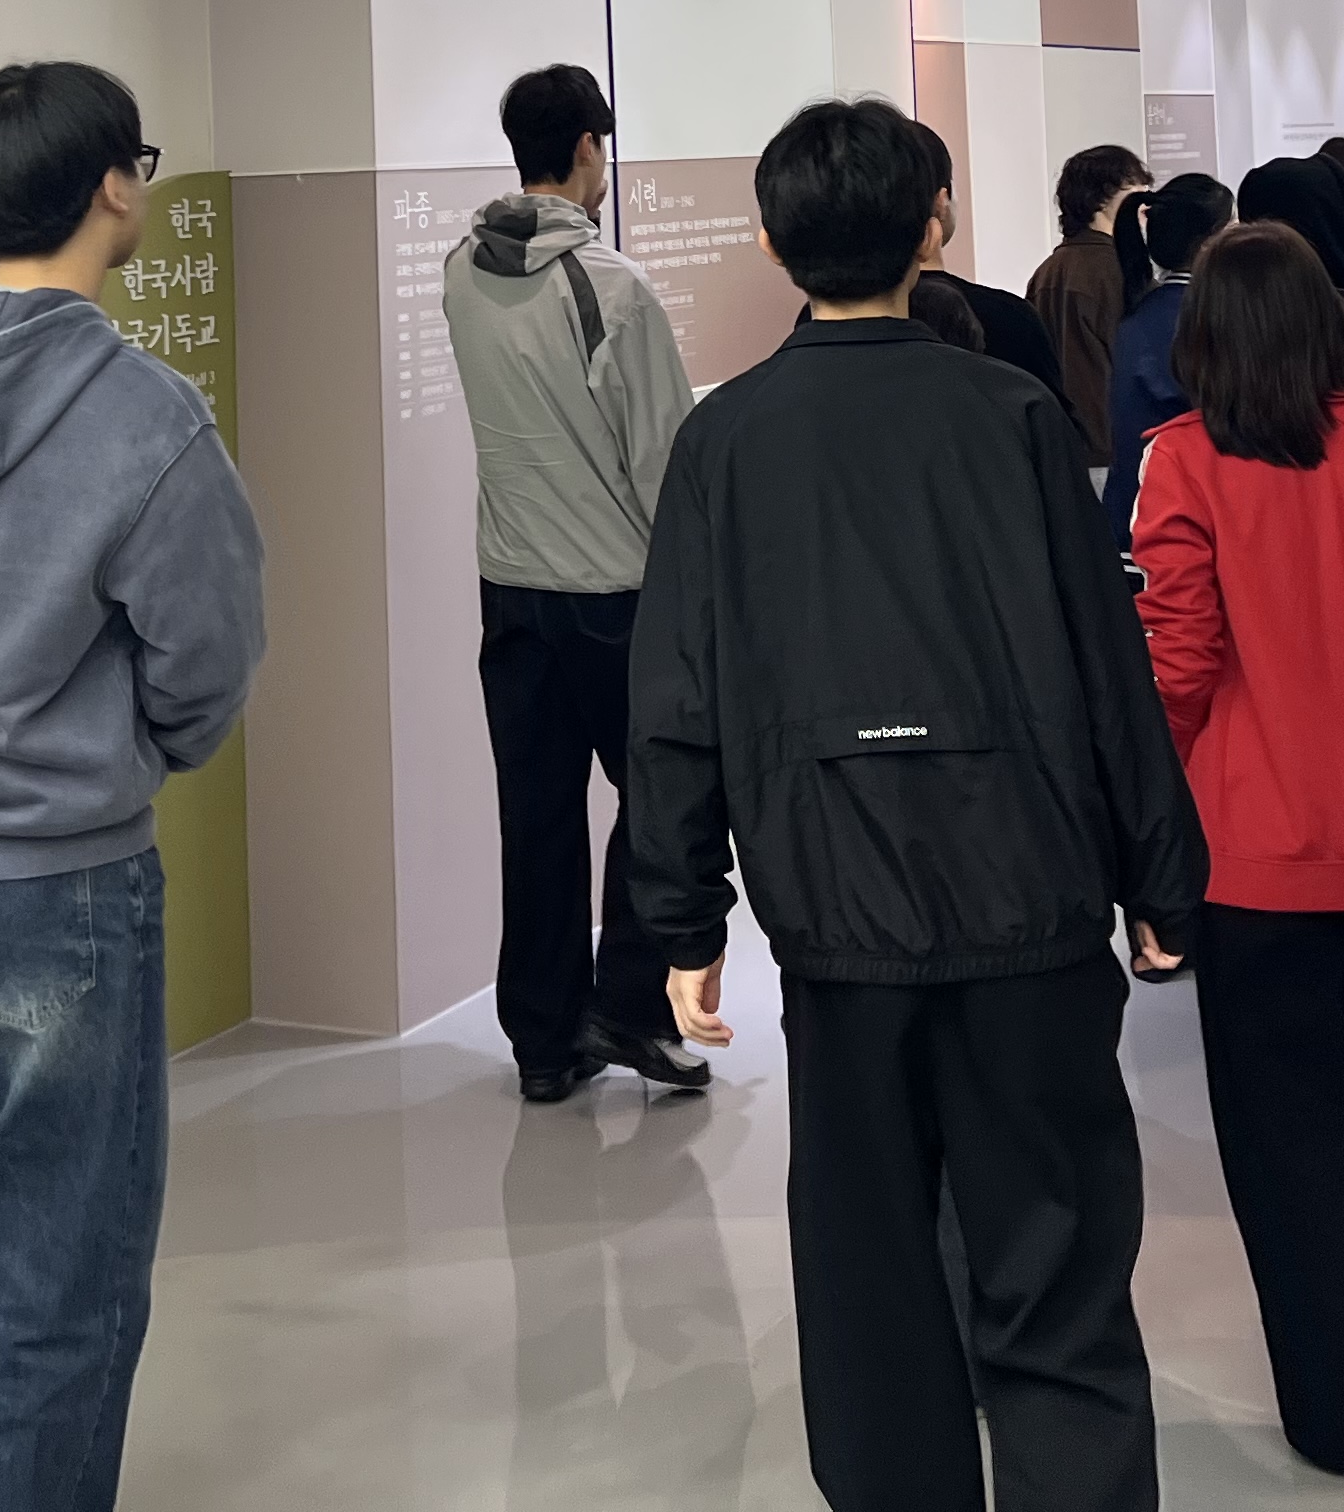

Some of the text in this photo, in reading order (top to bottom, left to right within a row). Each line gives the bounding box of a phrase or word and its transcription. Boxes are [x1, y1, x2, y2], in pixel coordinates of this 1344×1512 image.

[393, 190, 432, 229] 파종
[628, 177, 657, 213] 시련
[168, 198, 216, 239] 한국
[121, 252, 218, 302] 한국사람
[112, 313, 220, 355] 국기독교
[882, 726, 928, 739] balance
